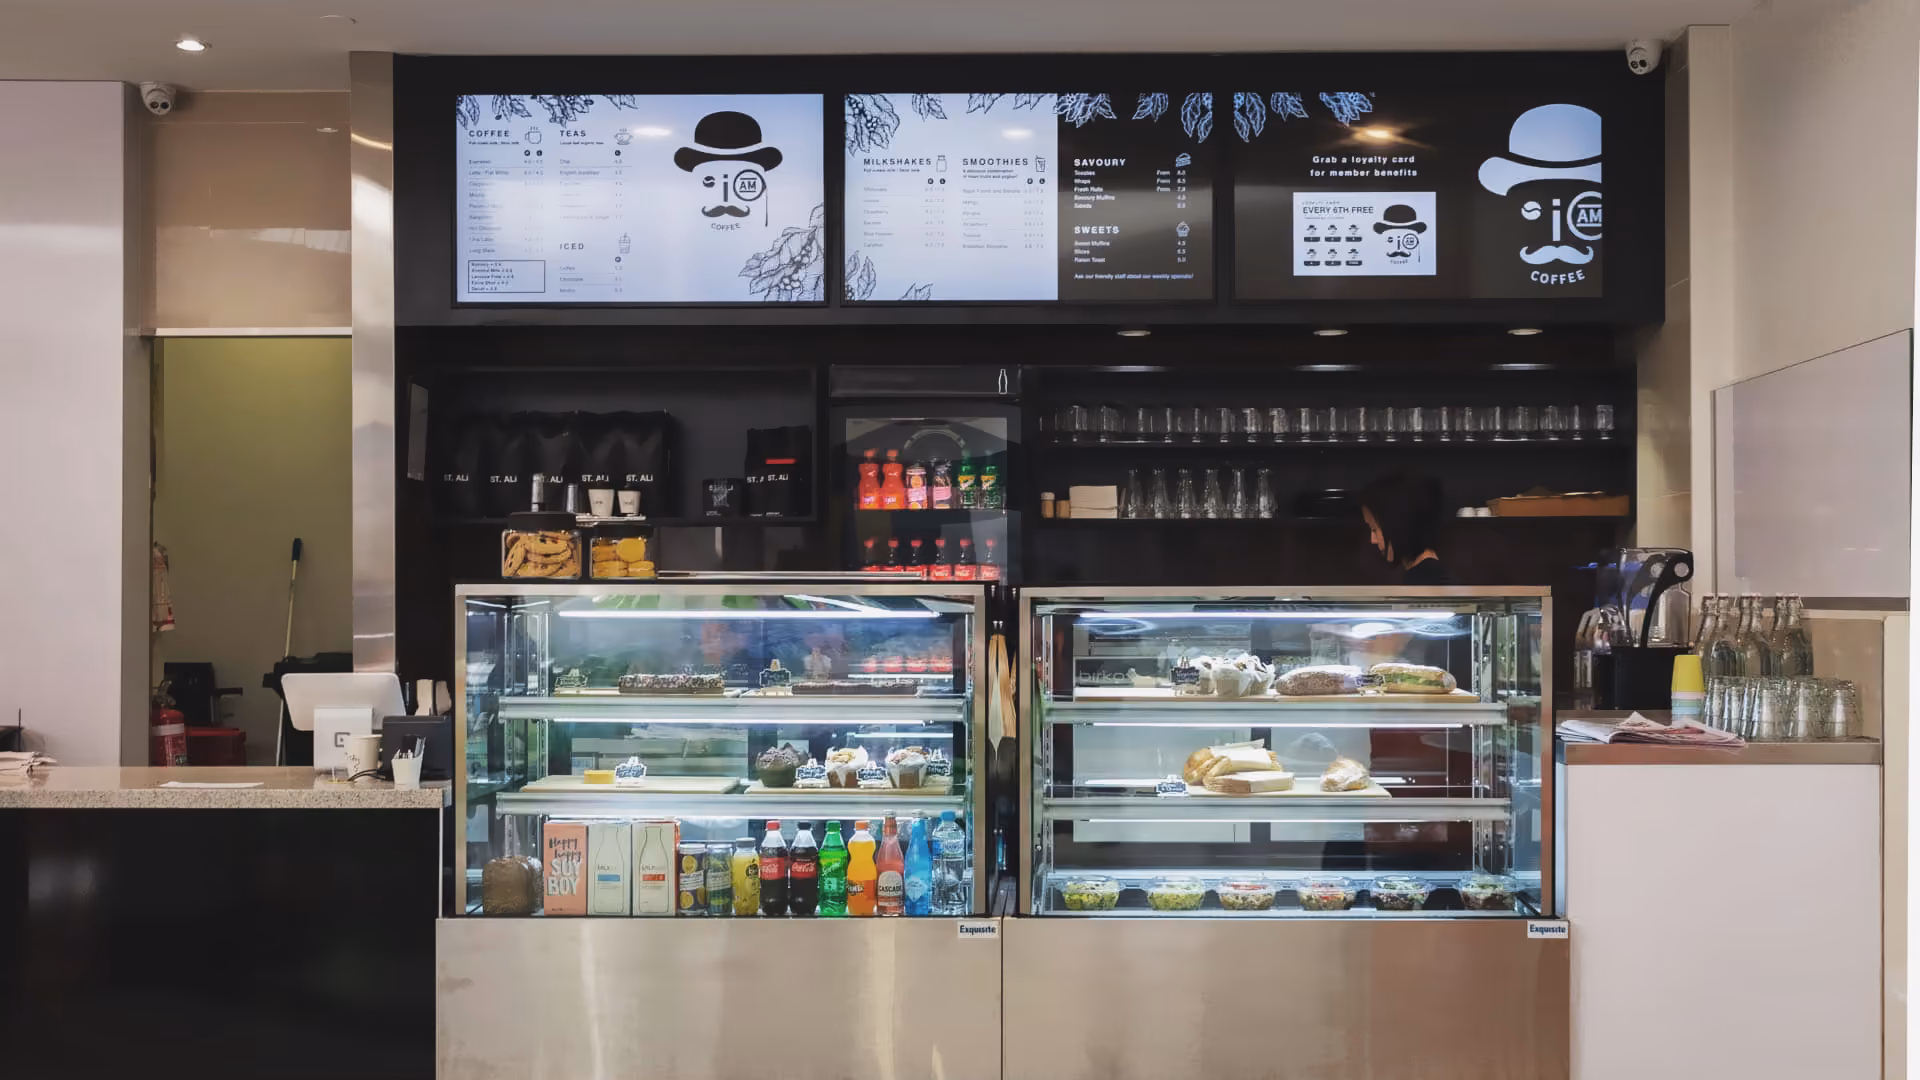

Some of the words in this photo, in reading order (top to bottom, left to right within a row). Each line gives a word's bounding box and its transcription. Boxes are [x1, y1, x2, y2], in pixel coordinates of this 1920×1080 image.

[863, 158, 932, 166] MILKSHAKES
[962, 158, 1029, 166] SMOOTHIES
[1073, 158, 1126, 167] SAVOURY
[1312, 155, 1338, 163] Grab
[1351, 155, 1388, 165] loyalty
[1392, 155, 1415, 163] card
[1310, 169, 1325, 177] for
[1329, 169, 1370, 177] member
[1374, 169, 1418, 177] benefits
[739, 181, 757, 190] AM
[1303, 206, 1331, 214] EVERY
[1333, 206, 1349, 214] 6TH
[1351, 206, 1374, 214] FREE
[1576, 208, 1602, 223] AM
[711, 222, 741, 231] COFFEE
[1073, 226, 1120, 234] SWEETS
[1530, 269, 1586, 284] COFFEE
[490, 475, 502, 483] ST.
[581, 474, 593, 482] ST.
[626, 474, 638, 482] ST.
[549, 837, 578, 850] Happy
[554, 849, 582, 863] happy
[547, 876, 577, 896] BOY
[959, 924, 996, 935] Exquisite
[1529, 924, 1566, 935] Exquisite
